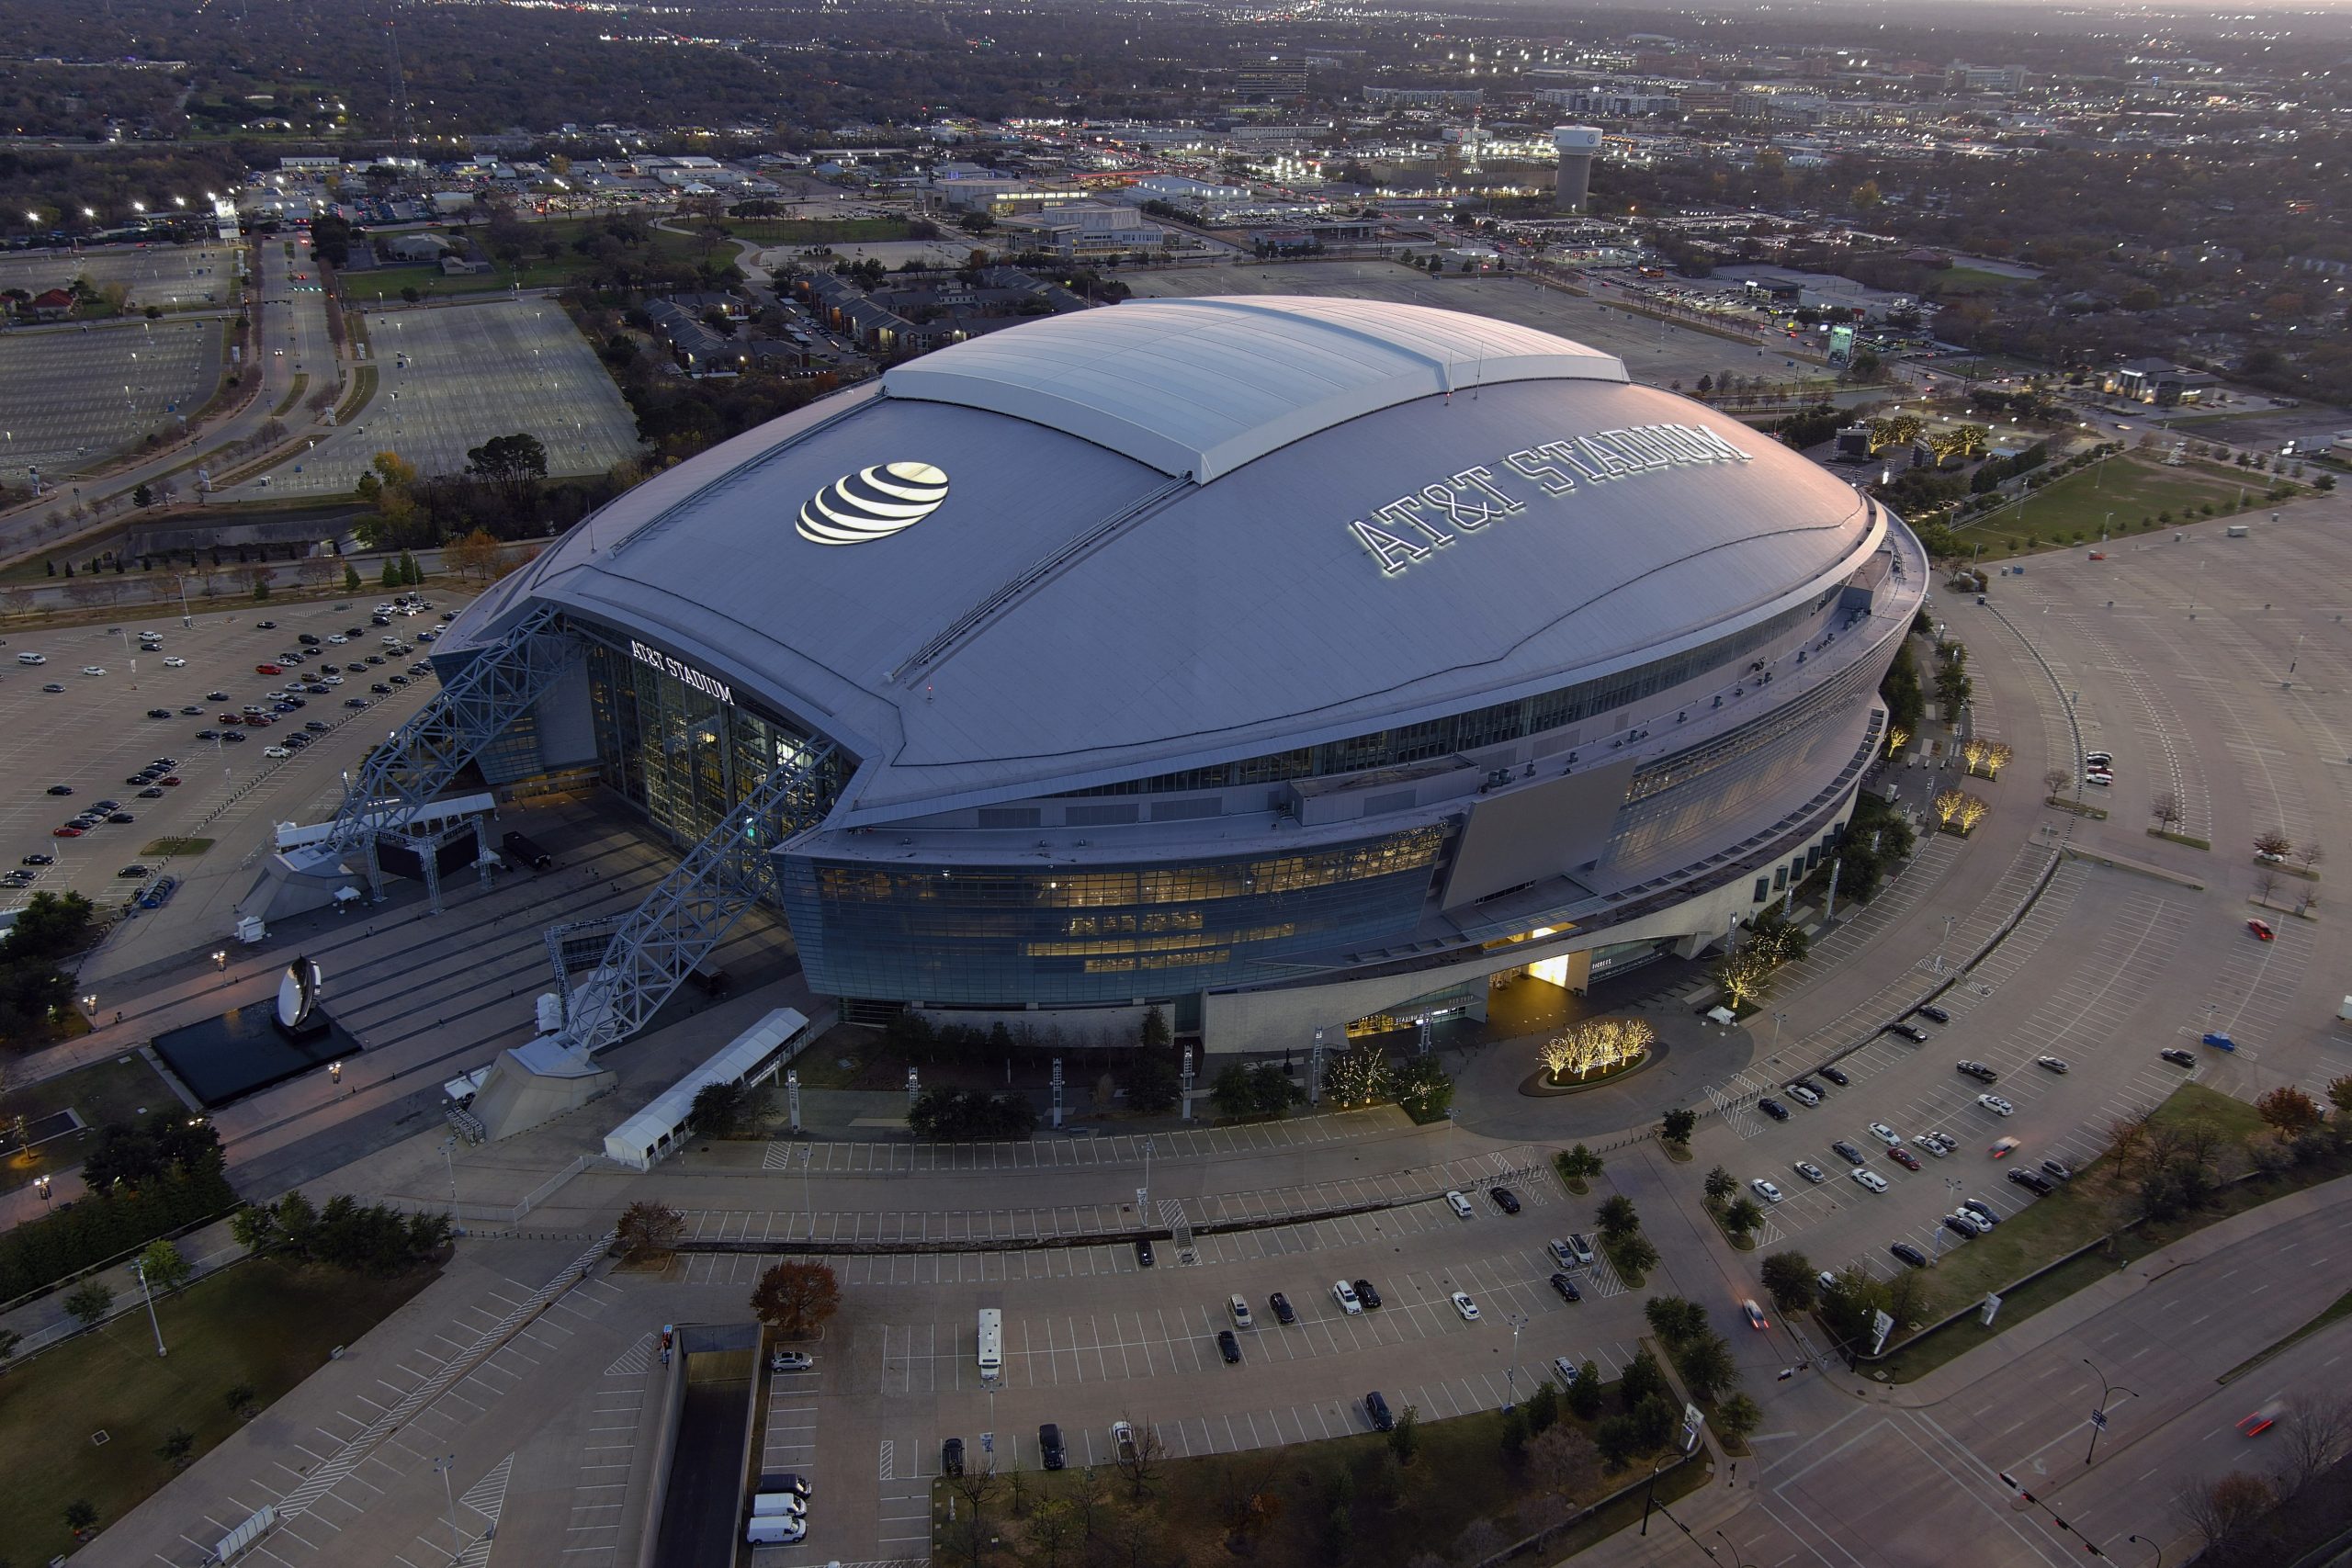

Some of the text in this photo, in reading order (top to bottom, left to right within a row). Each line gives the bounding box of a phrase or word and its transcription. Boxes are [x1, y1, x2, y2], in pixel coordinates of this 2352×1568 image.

[1349, 423, 1754, 574] AT&T STADIUM
[631, 639, 735, 705] AT&T STADIUM
